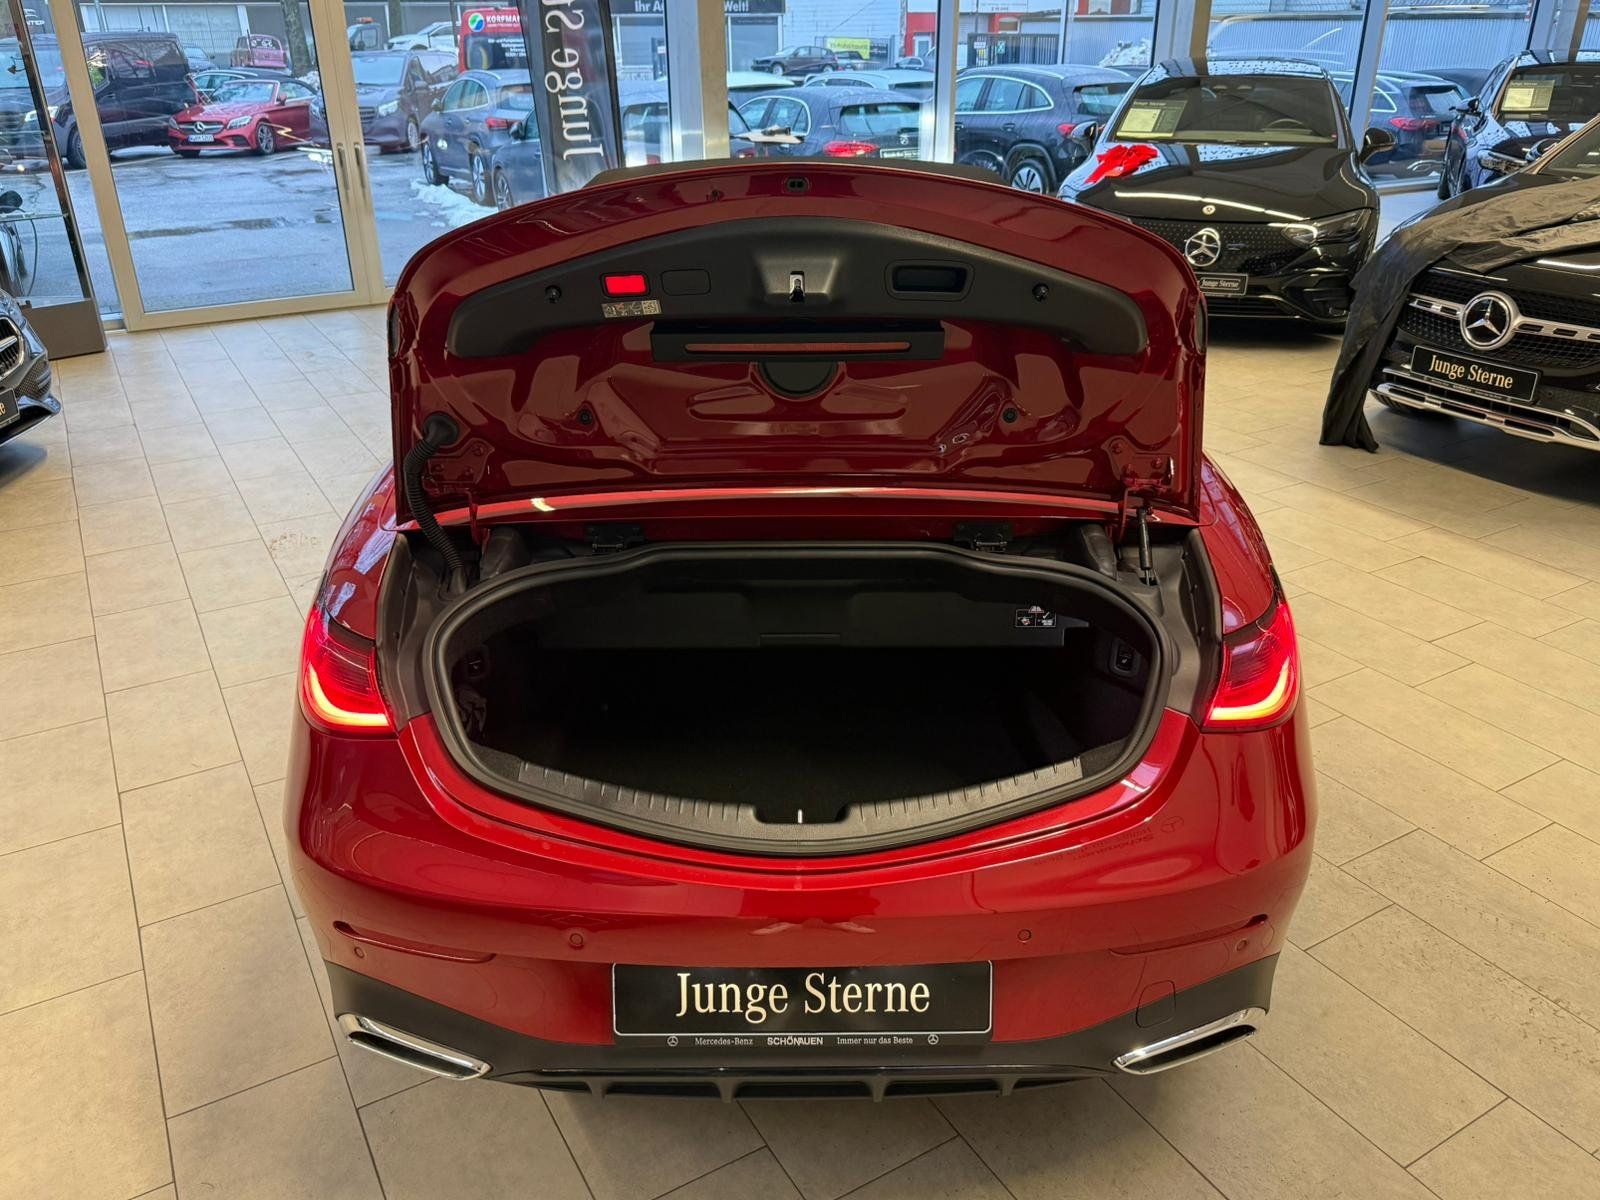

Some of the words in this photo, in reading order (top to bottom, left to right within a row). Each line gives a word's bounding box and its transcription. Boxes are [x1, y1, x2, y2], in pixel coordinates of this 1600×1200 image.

[1428, 354, 1465, 380] Junge
[1467, 364, 1513, 389] Sterne
[676, 972, 789, 1024] Junge
[804, 972, 930, 1014] Sterne
[694, 1037, 754, 1046] Mercedes-Benz
[837, 1036, 862, 1045] Immer
[863, 1037, 877, 1045] nur
[878, 1036, 892, 1045] das
[893, 1036, 914, 1045] Beste
